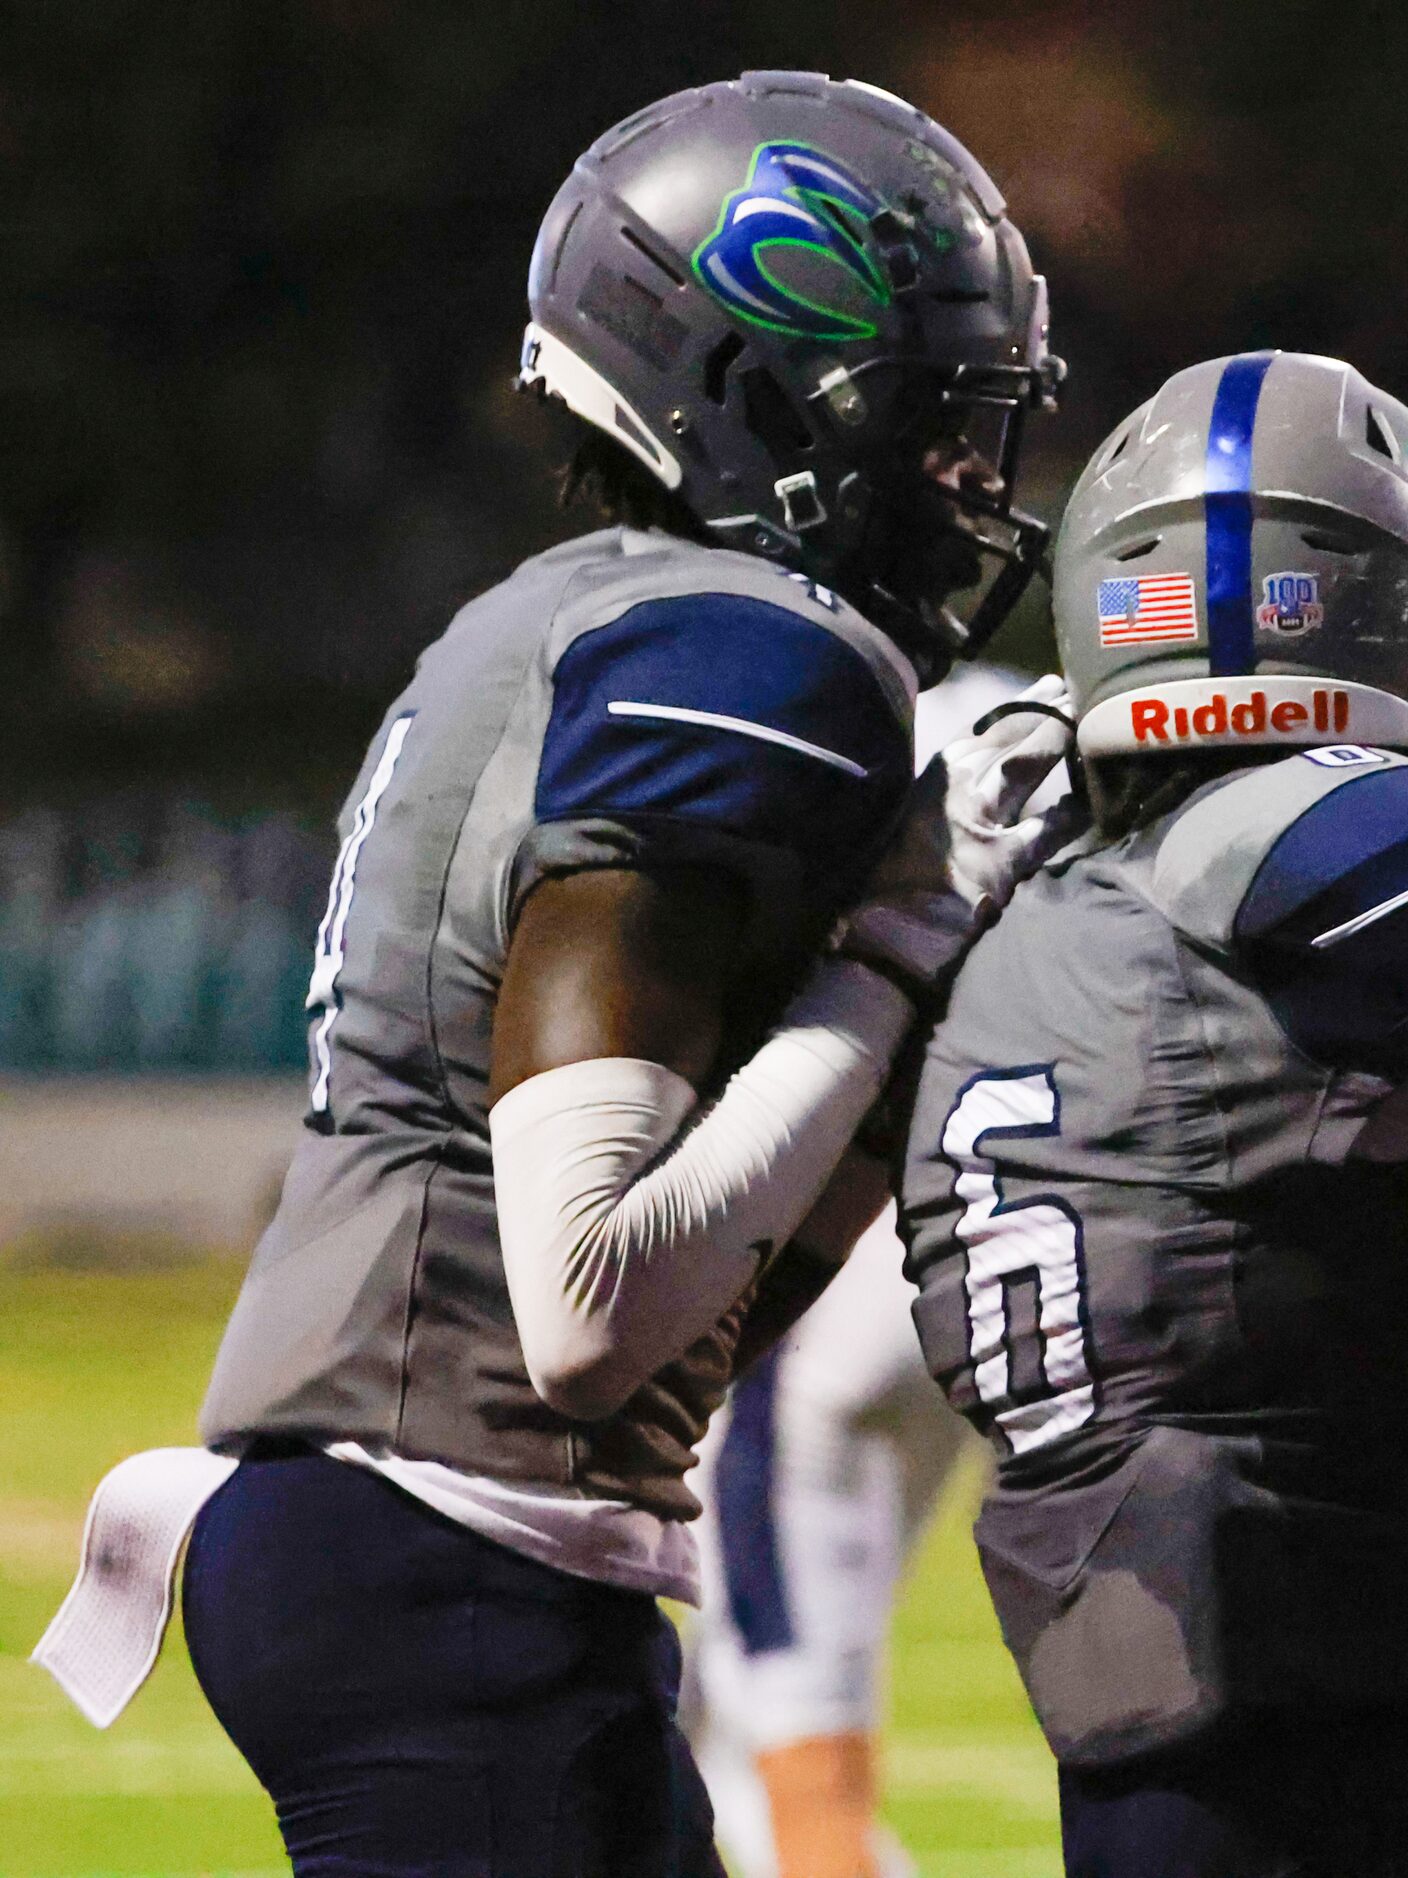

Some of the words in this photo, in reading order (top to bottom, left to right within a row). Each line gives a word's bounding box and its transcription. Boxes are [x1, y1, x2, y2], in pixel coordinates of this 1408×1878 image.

[1267, 575, 1314, 610] 100
[1130, 690, 1350, 742] Riddell
[940, 1062, 1098, 1456] 6
